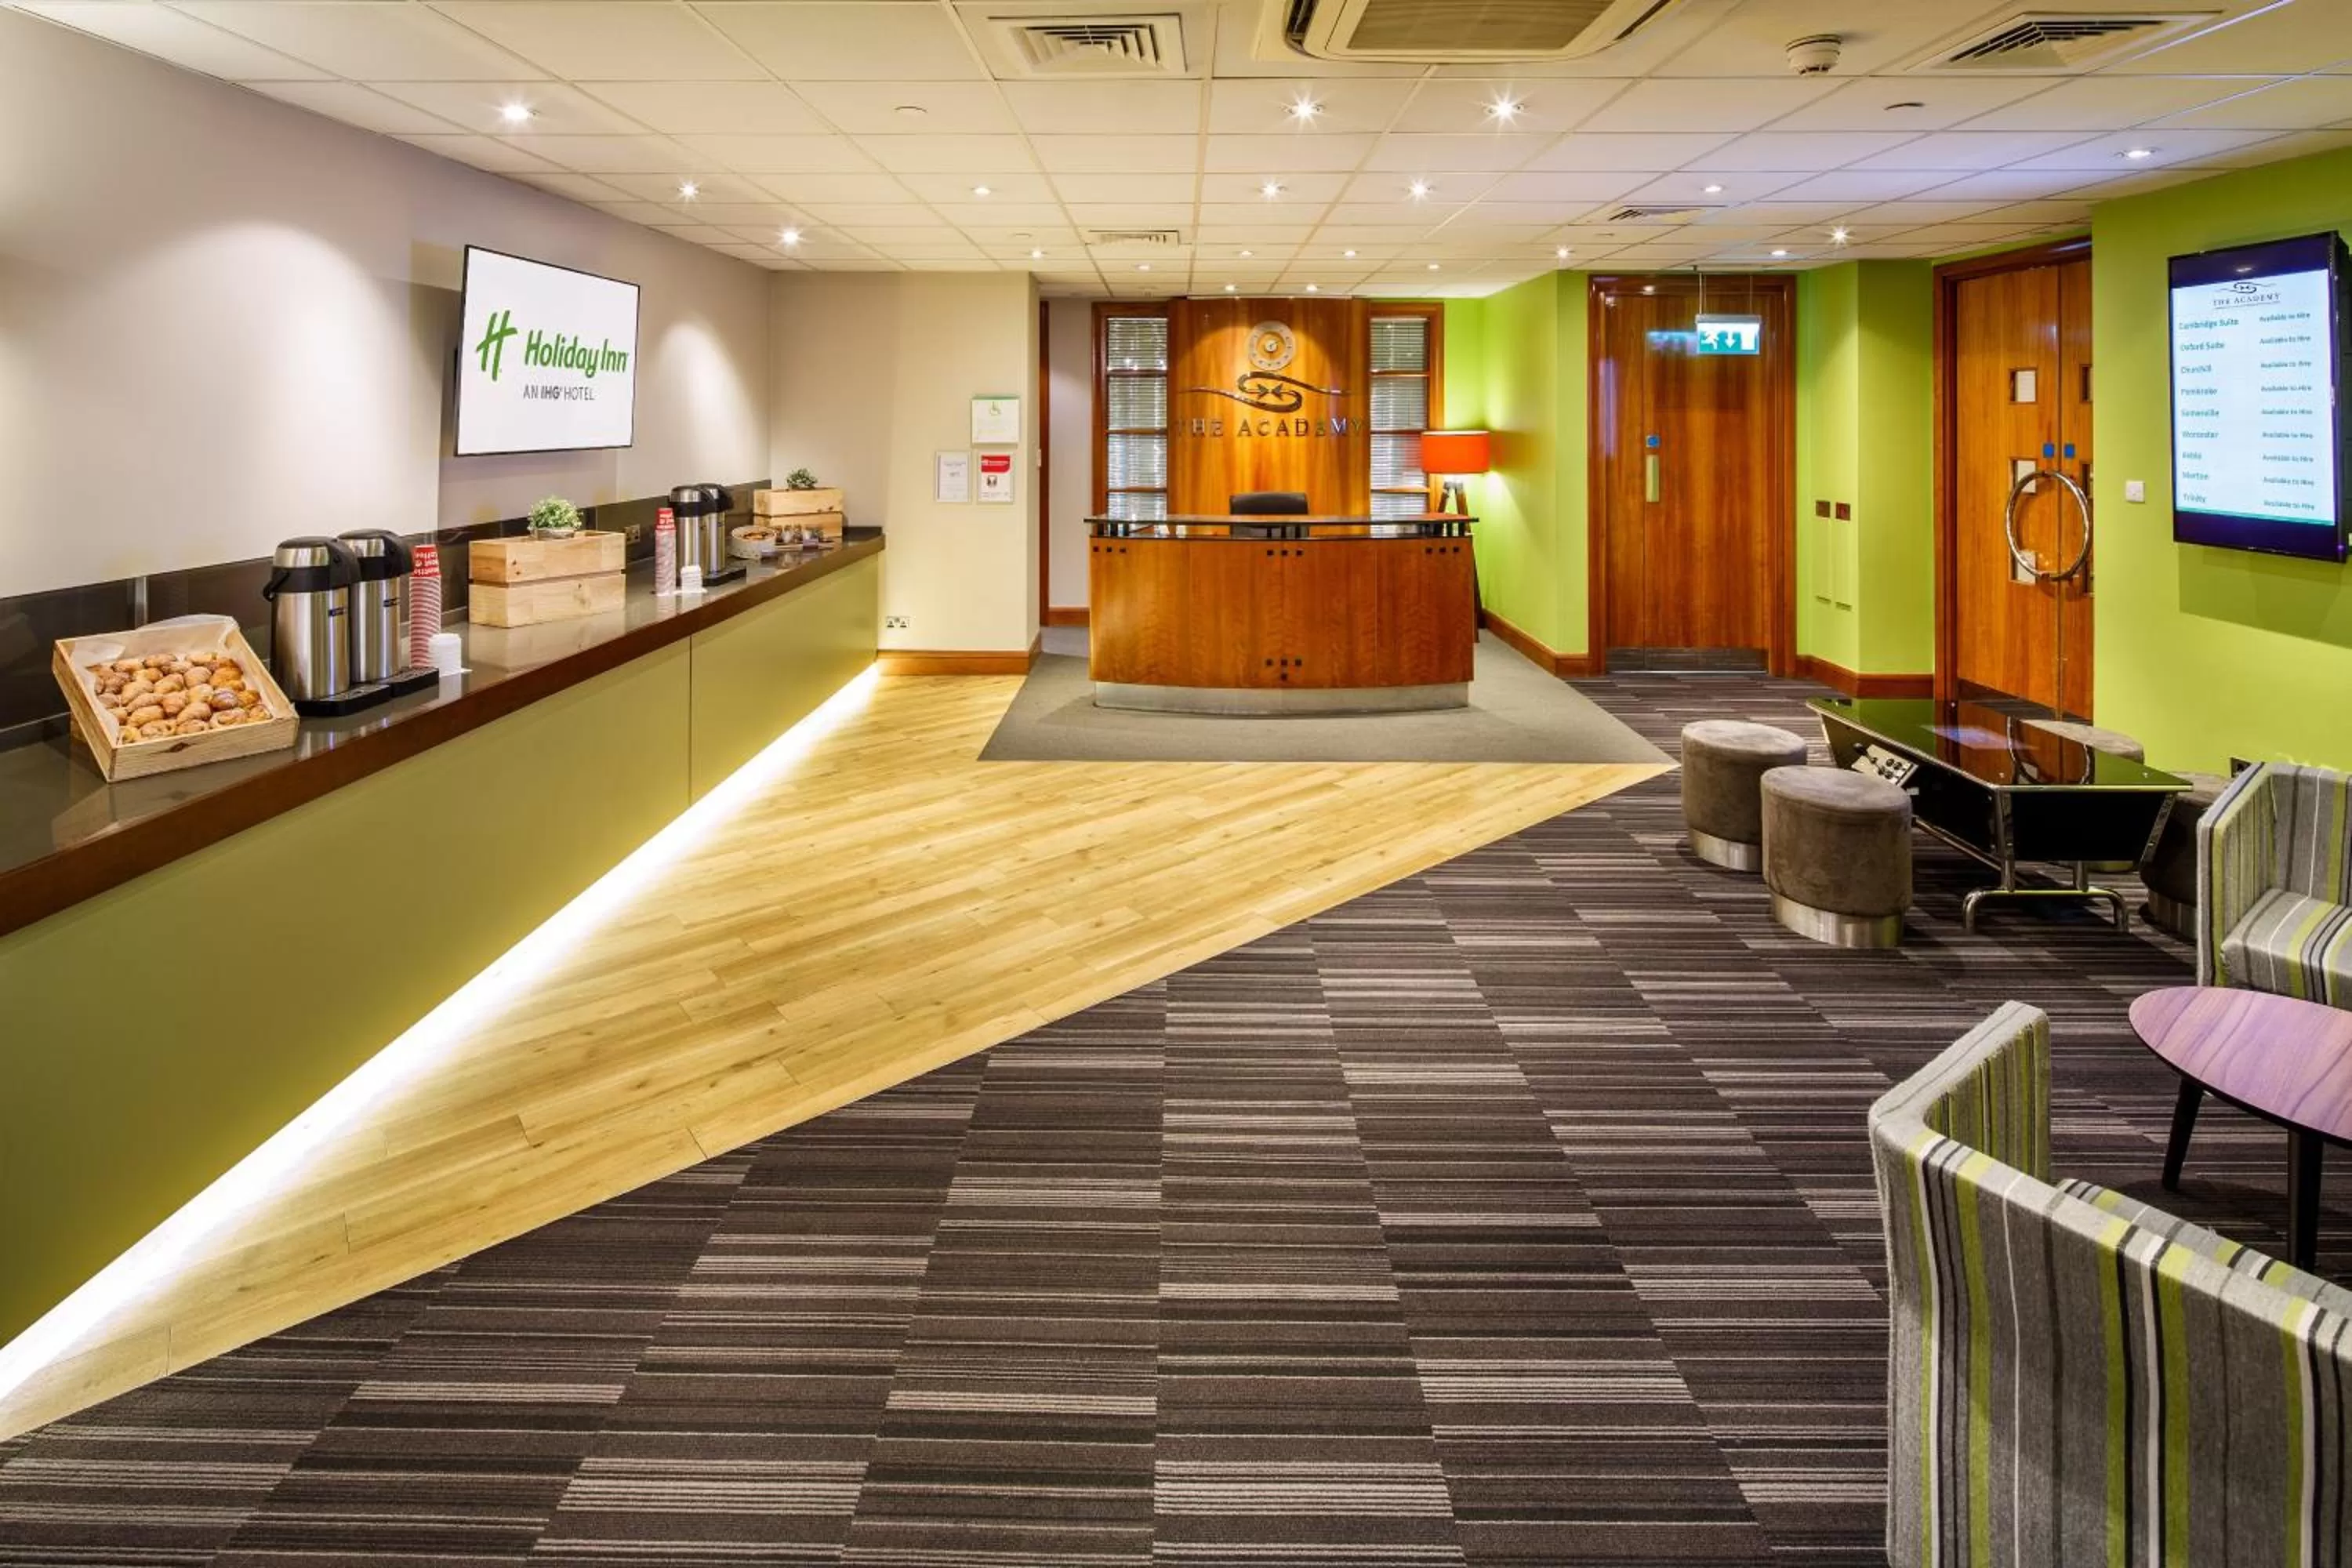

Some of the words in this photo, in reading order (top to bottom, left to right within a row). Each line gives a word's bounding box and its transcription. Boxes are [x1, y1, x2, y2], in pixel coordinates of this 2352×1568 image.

[2234, 293, 2281, 304] ACADEMY
[524, 329, 600, 378] Holiday
[601, 339, 628, 372] Inn
[523, 384, 539, 399] AN
[564, 387, 595, 401] HOTEL
[1237, 418, 1362, 437] ACADEMY
